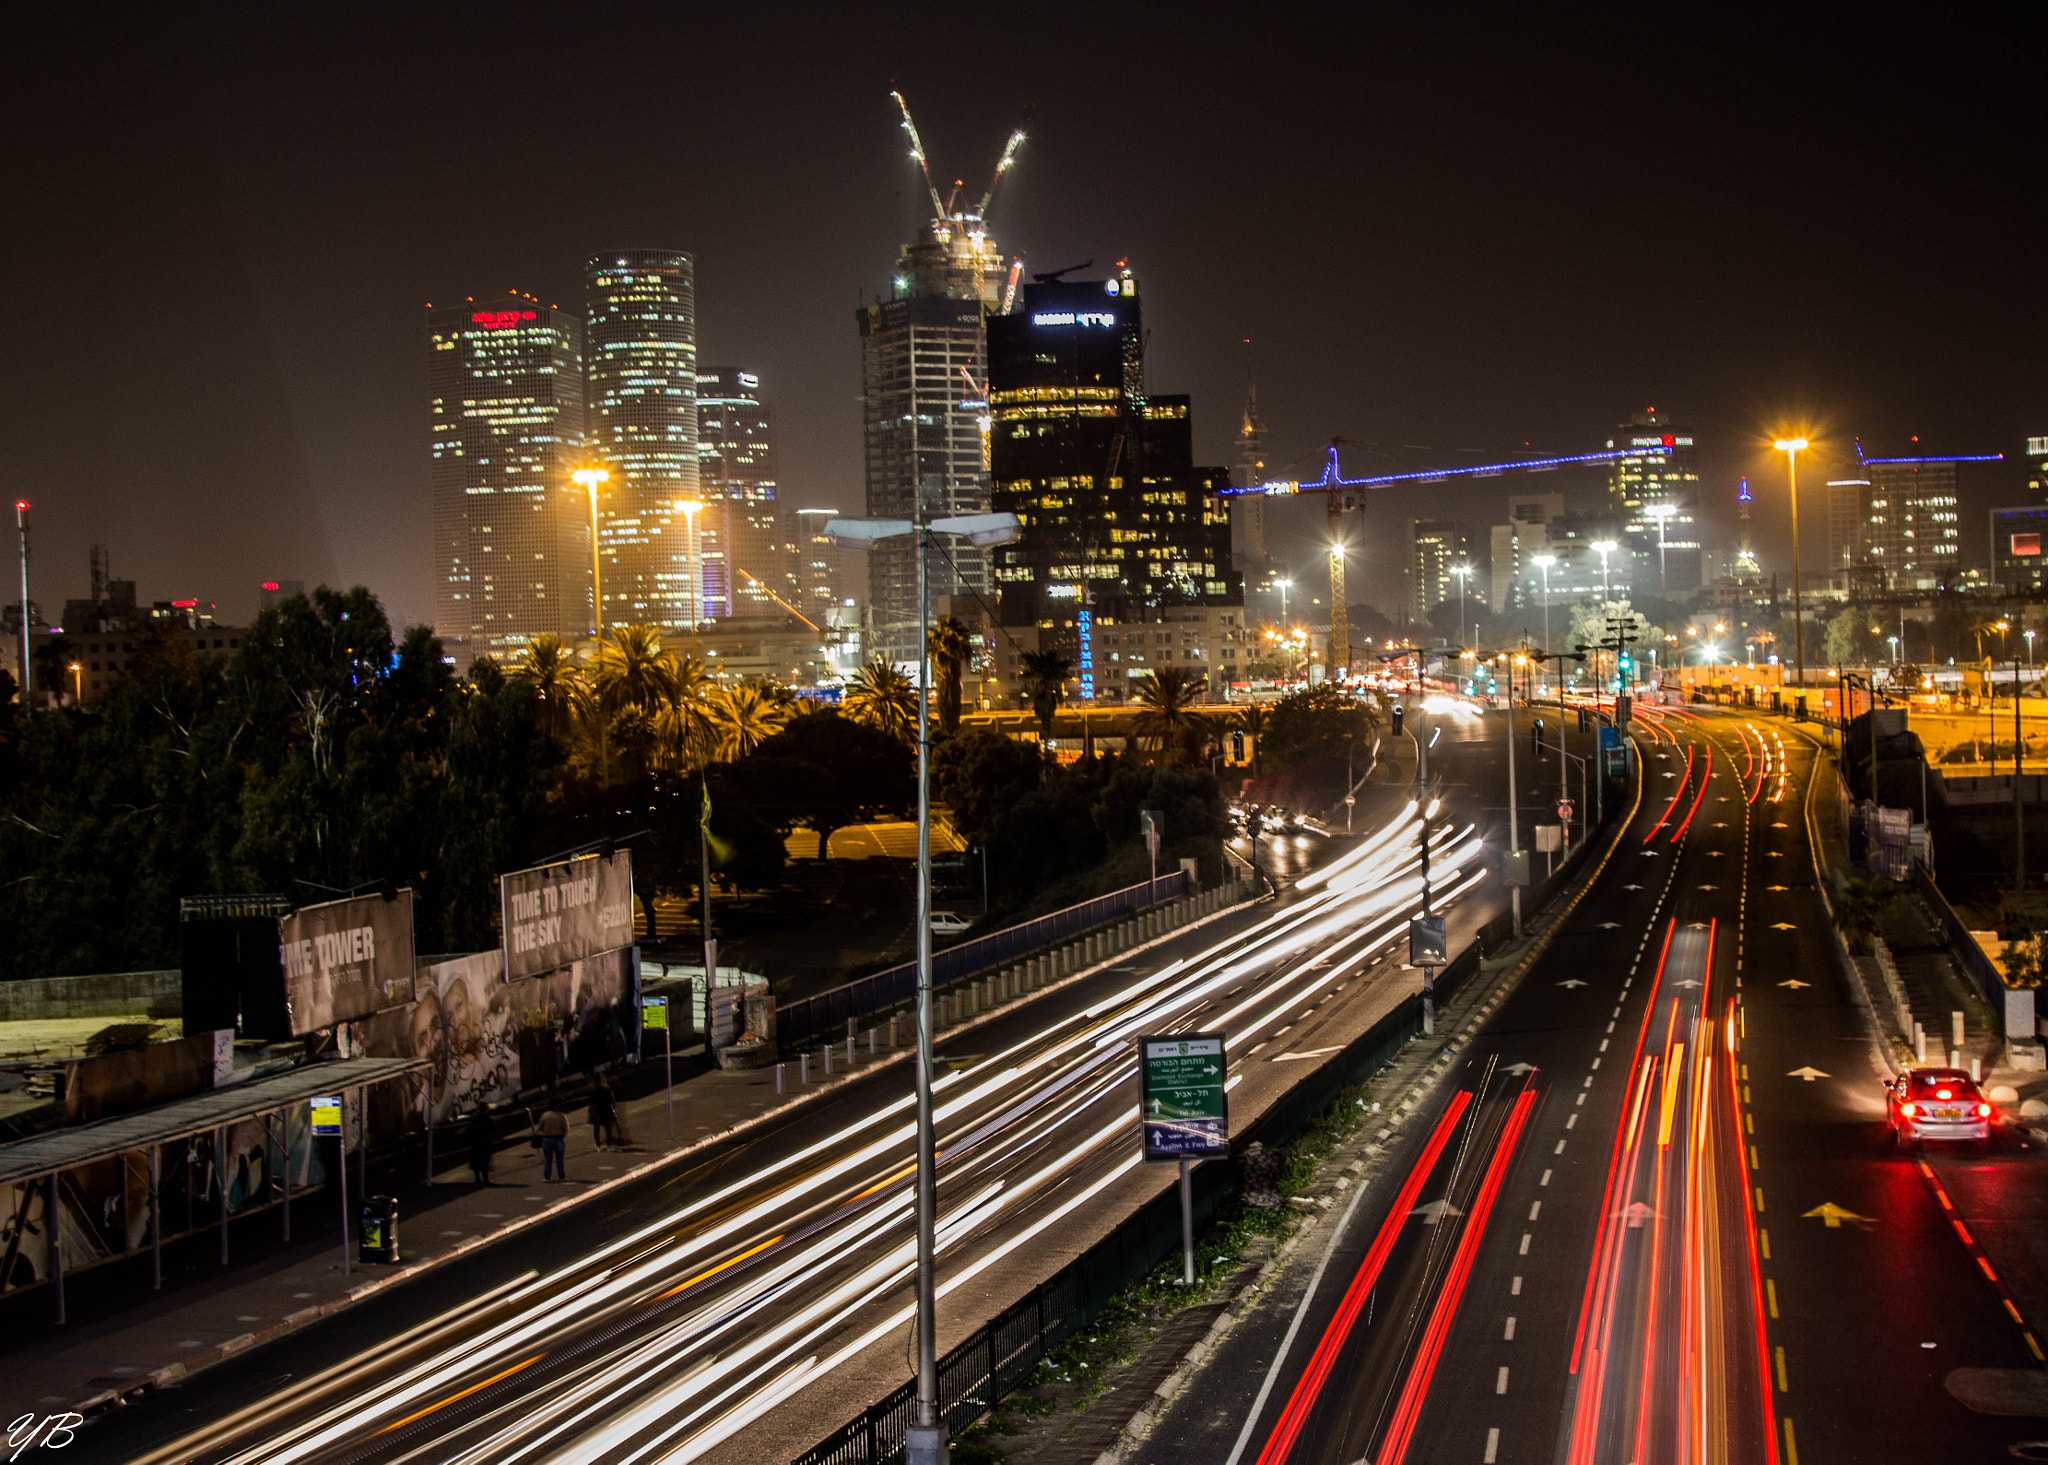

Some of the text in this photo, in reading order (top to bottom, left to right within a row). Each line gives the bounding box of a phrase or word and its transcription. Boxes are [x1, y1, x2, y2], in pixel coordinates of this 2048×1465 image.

[511, 876, 597, 922] TIME TO TOUCH
[315, 926, 375, 970] TOWER
[512, 922, 537, 954] THE
[538, 916, 562, 947] SKY
